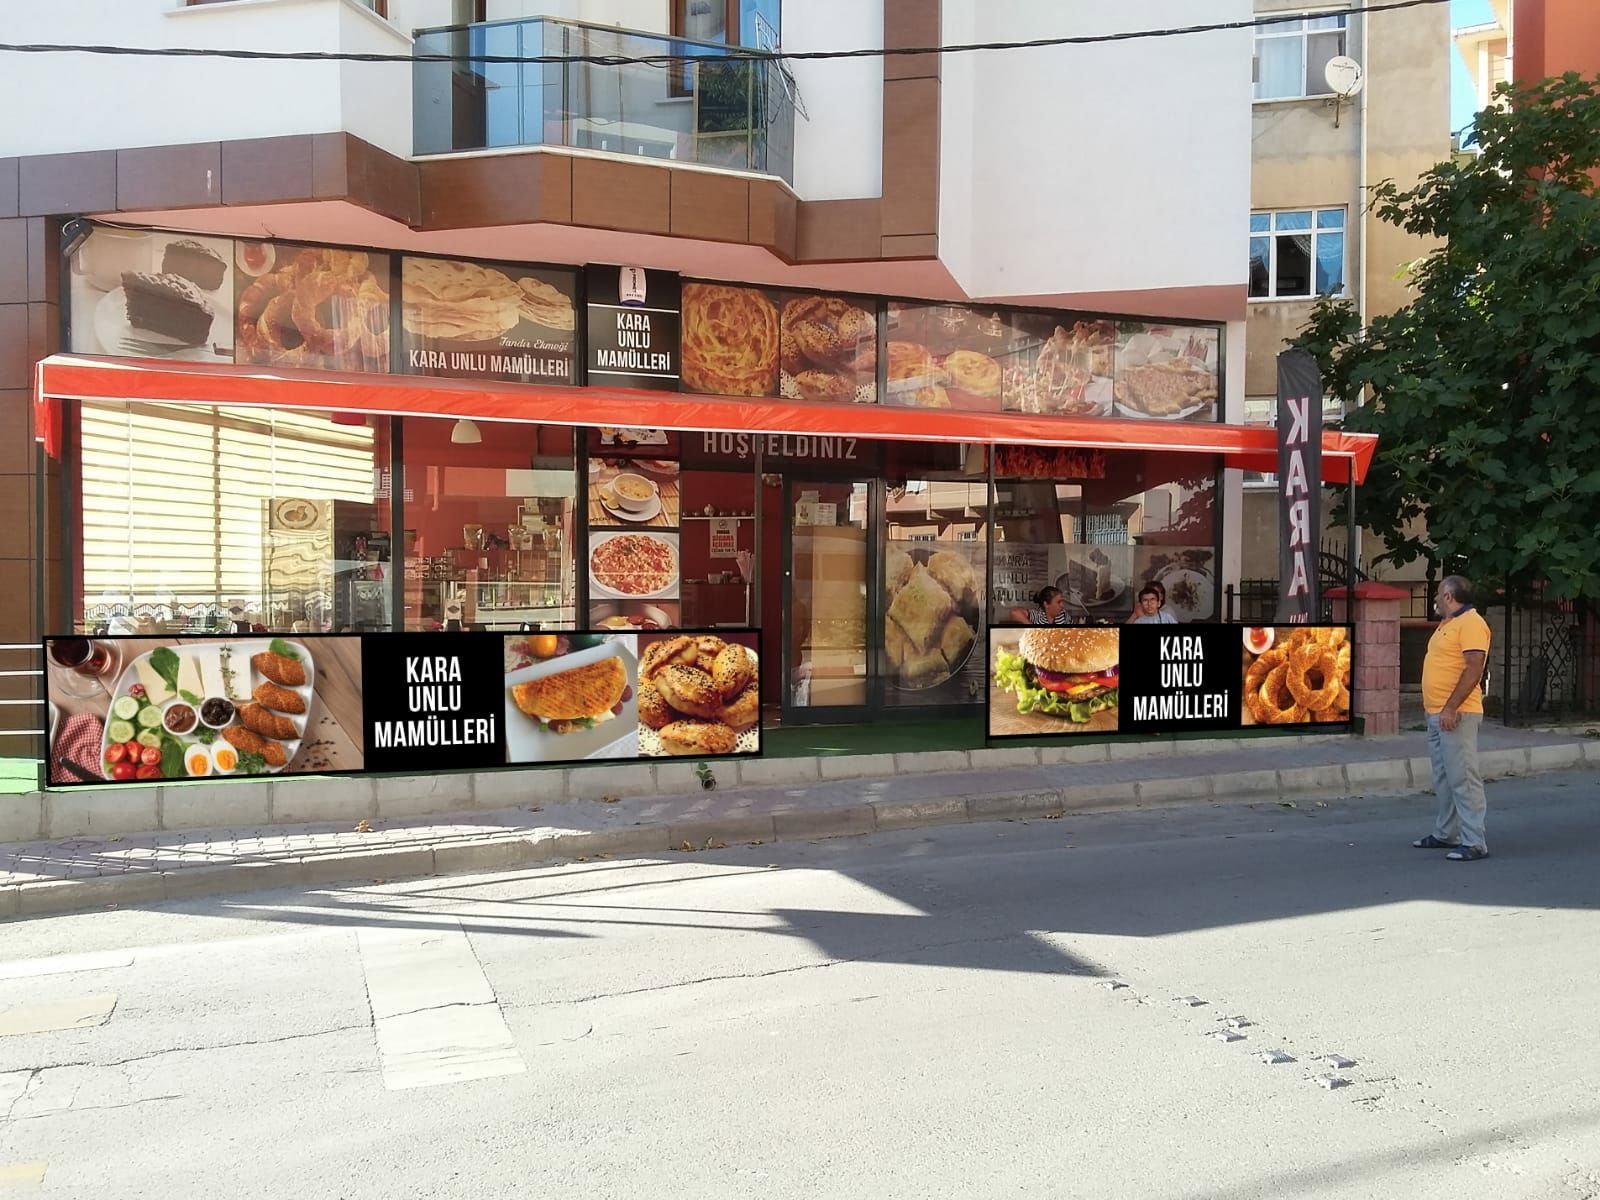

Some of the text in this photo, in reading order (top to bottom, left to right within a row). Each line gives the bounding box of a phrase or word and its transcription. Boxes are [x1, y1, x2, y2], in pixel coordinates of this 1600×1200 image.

[616, 312, 651, 332] KARA
[617, 330, 651, 349] UNLU
[409, 349, 569, 377] KARA UNLU MAMÜLLERİ
[597, 348, 671, 371] MAMÜLLERİ
[1160, 636, 1204, 661] KARA
[406, 656, 462, 683] KARA
[1161, 663, 1203, 688] UNLU
[408, 685, 462, 712] UNLU
[1133, 689, 1229, 721] MAMÜLLERİ
[375, 713, 496, 748] MAMÜLLERİ
